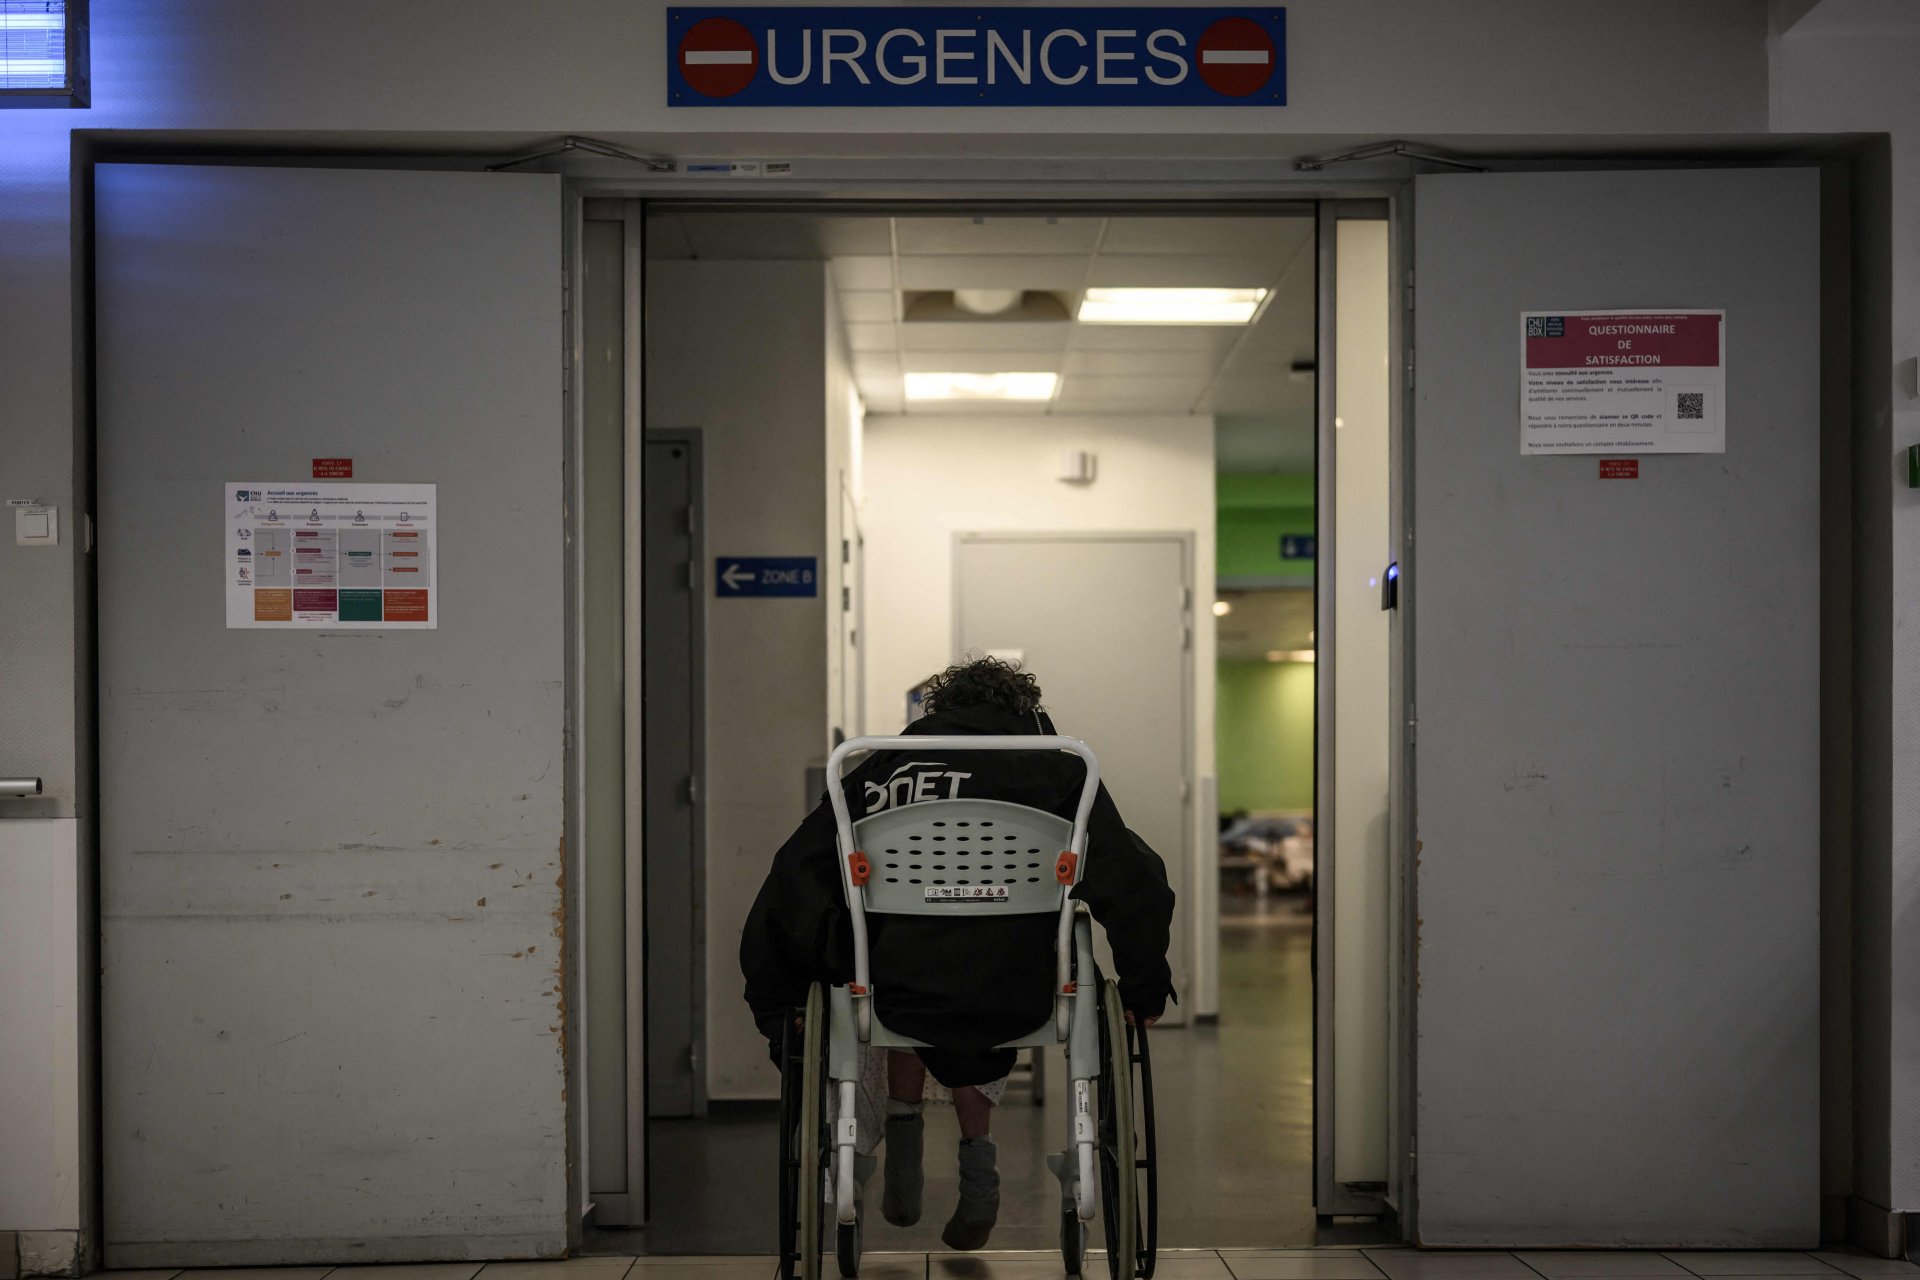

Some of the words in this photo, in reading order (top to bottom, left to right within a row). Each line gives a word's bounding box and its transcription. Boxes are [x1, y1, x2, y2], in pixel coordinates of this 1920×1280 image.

[767, 28, 1188, 86] URGENCES
[1588, 324, 1676, 336] QUESTIONNAIRE
[1617, 340, 1632, 350] DE
[1585, 354, 1661, 366] SATISFACTION
[762, 569, 800, 585] ZONE
[802, 569, 813, 585] B
